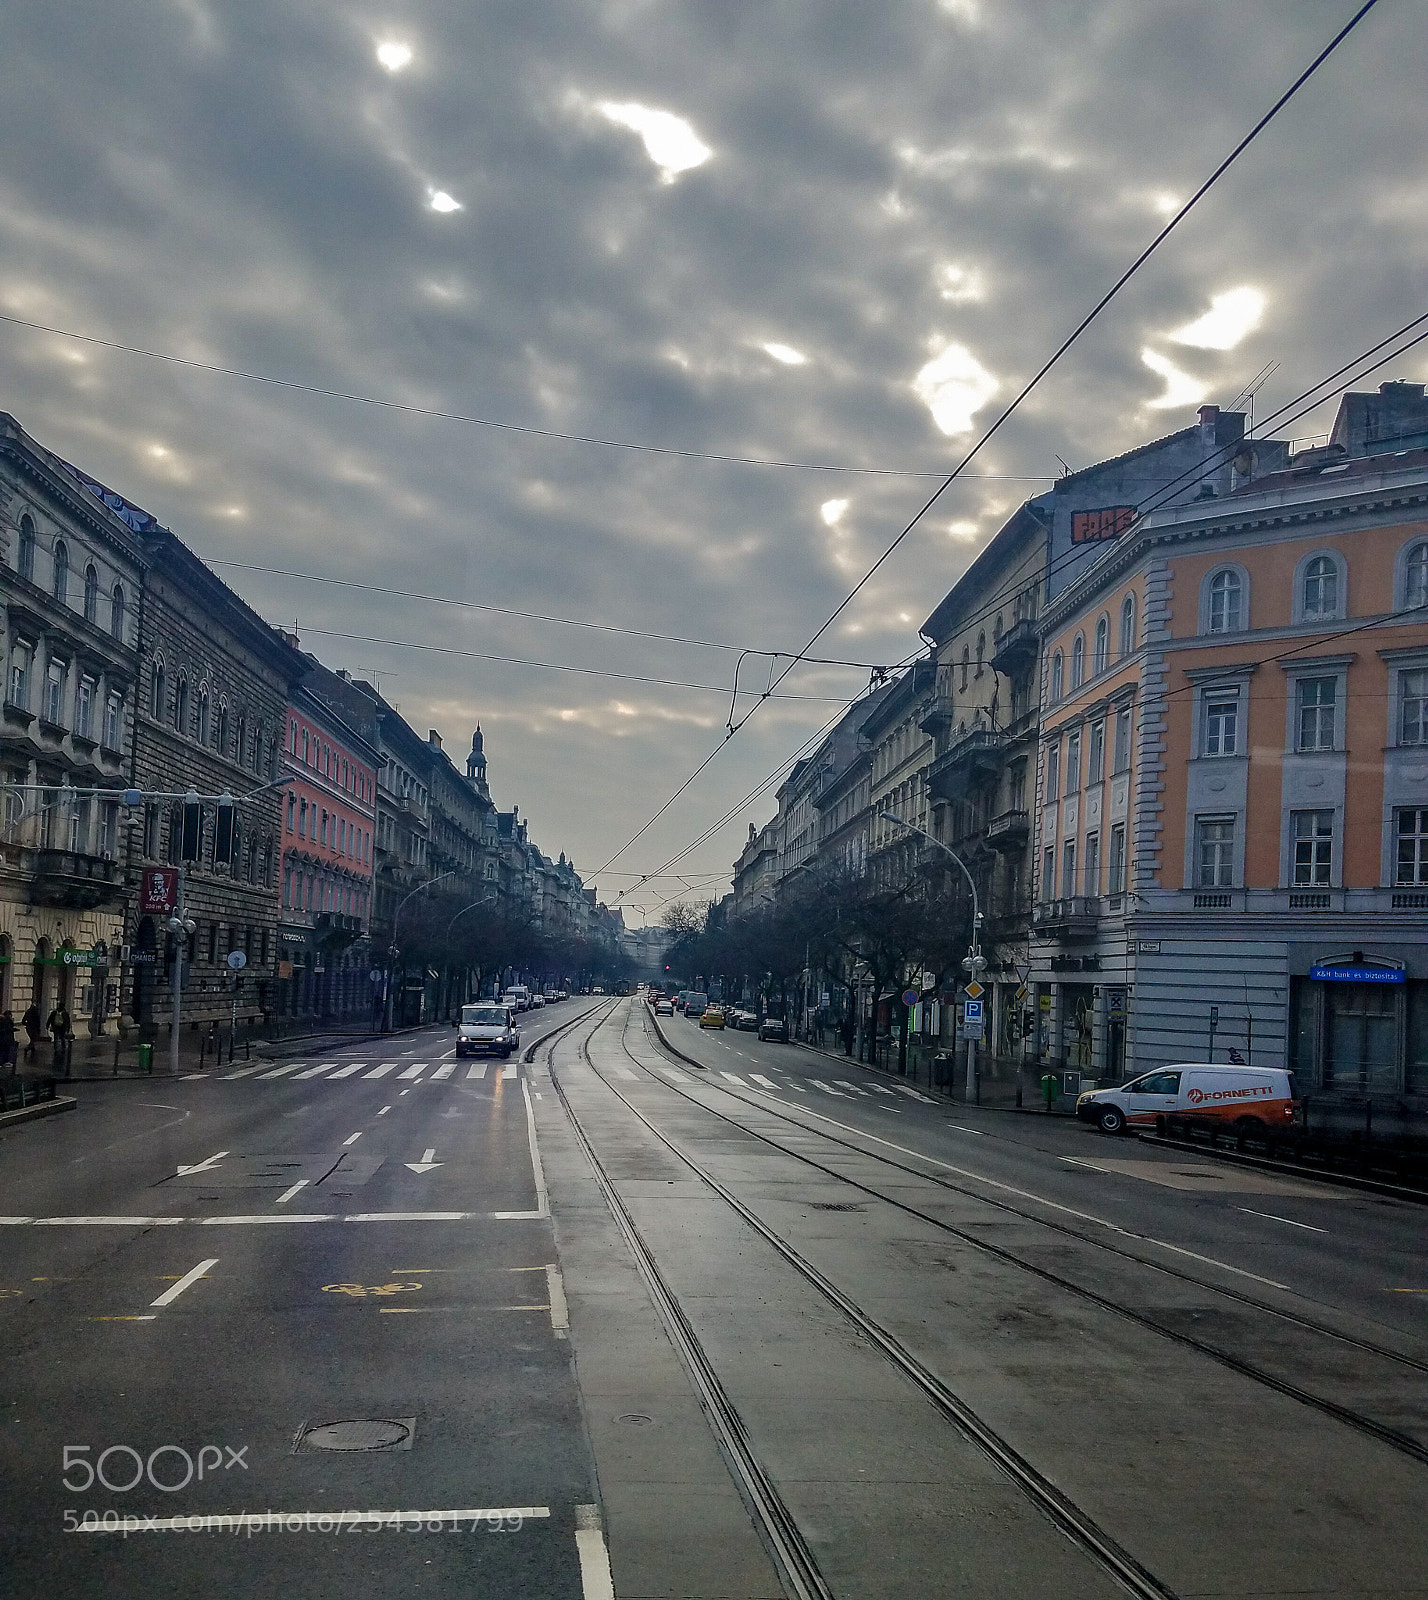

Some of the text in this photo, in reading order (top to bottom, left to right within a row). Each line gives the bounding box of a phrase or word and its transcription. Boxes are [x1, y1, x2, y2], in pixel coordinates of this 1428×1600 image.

[130, 954, 156, 962] CHANGE
[969, 1003, 978, 1015] P
[1203, 1086, 1273, 1100] FORNETTI
